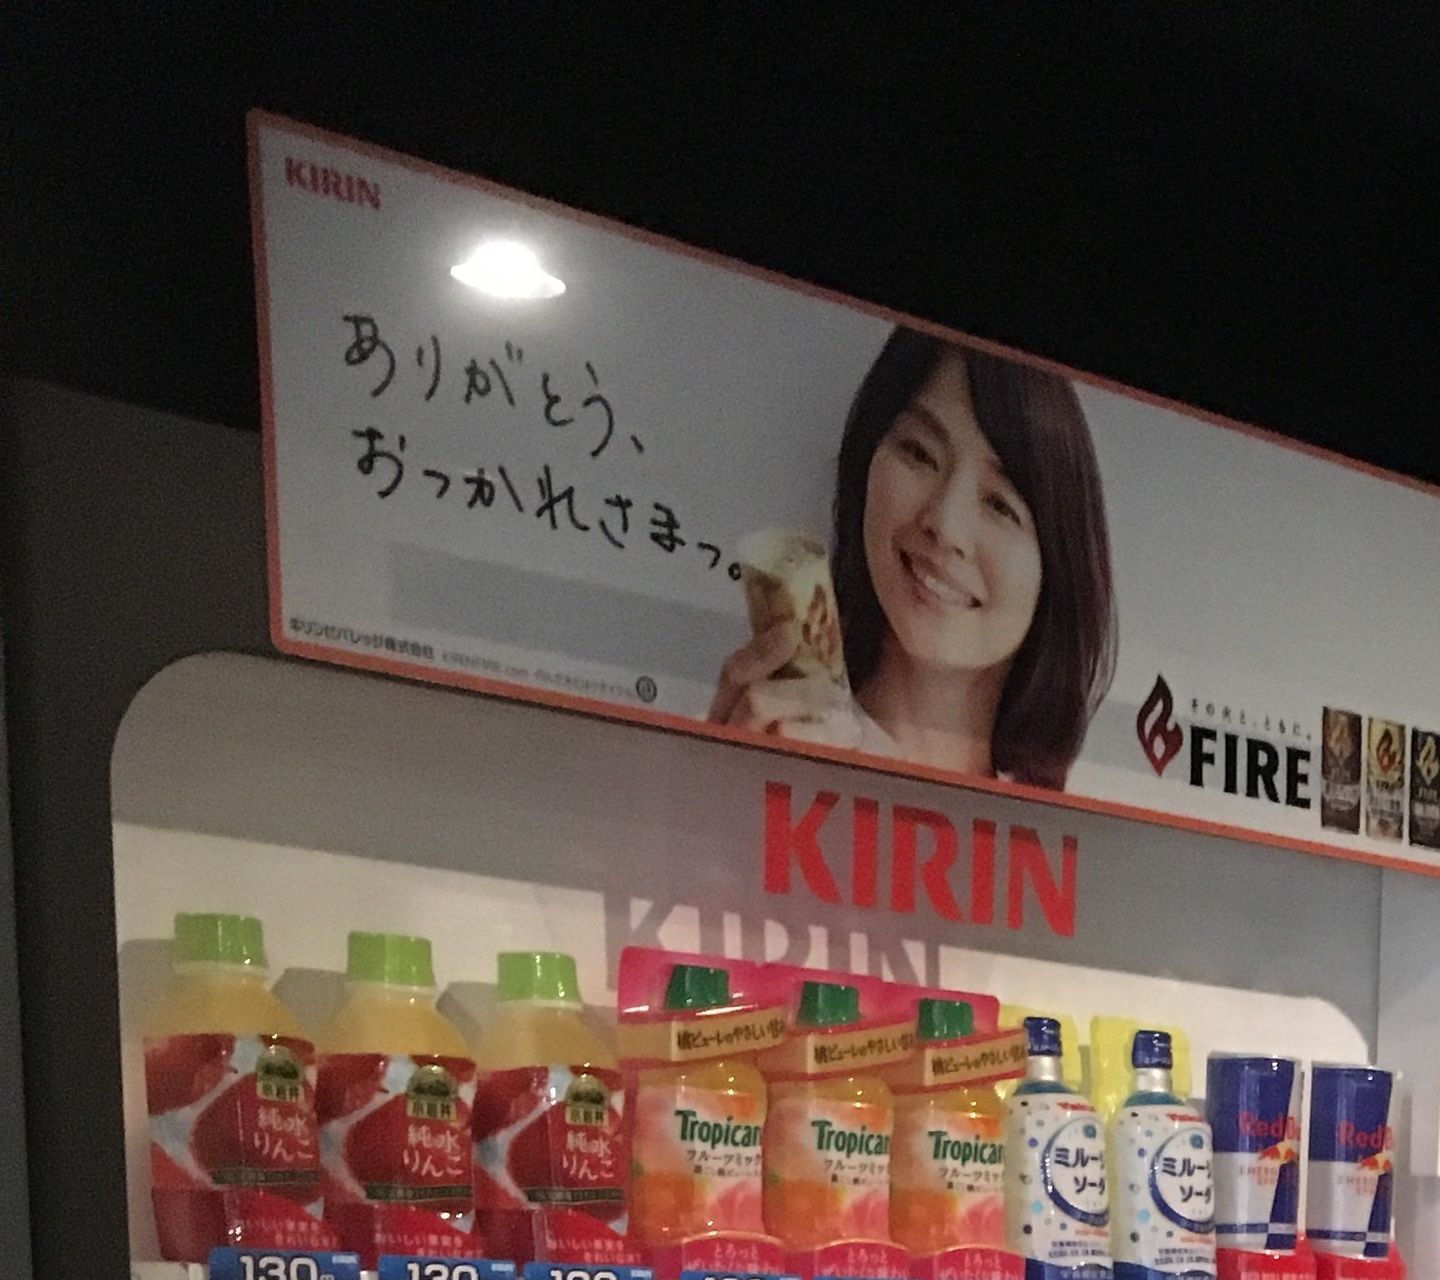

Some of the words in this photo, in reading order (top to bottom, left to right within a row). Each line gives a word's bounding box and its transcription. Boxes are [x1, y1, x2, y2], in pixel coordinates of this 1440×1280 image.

[284, 157, 381, 209] KIRIN
[342, 315, 644, 457] ありがとう、
[1190, 725, 1311, 809] FIRE
[763, 781, 1079, 938] KIRIN
